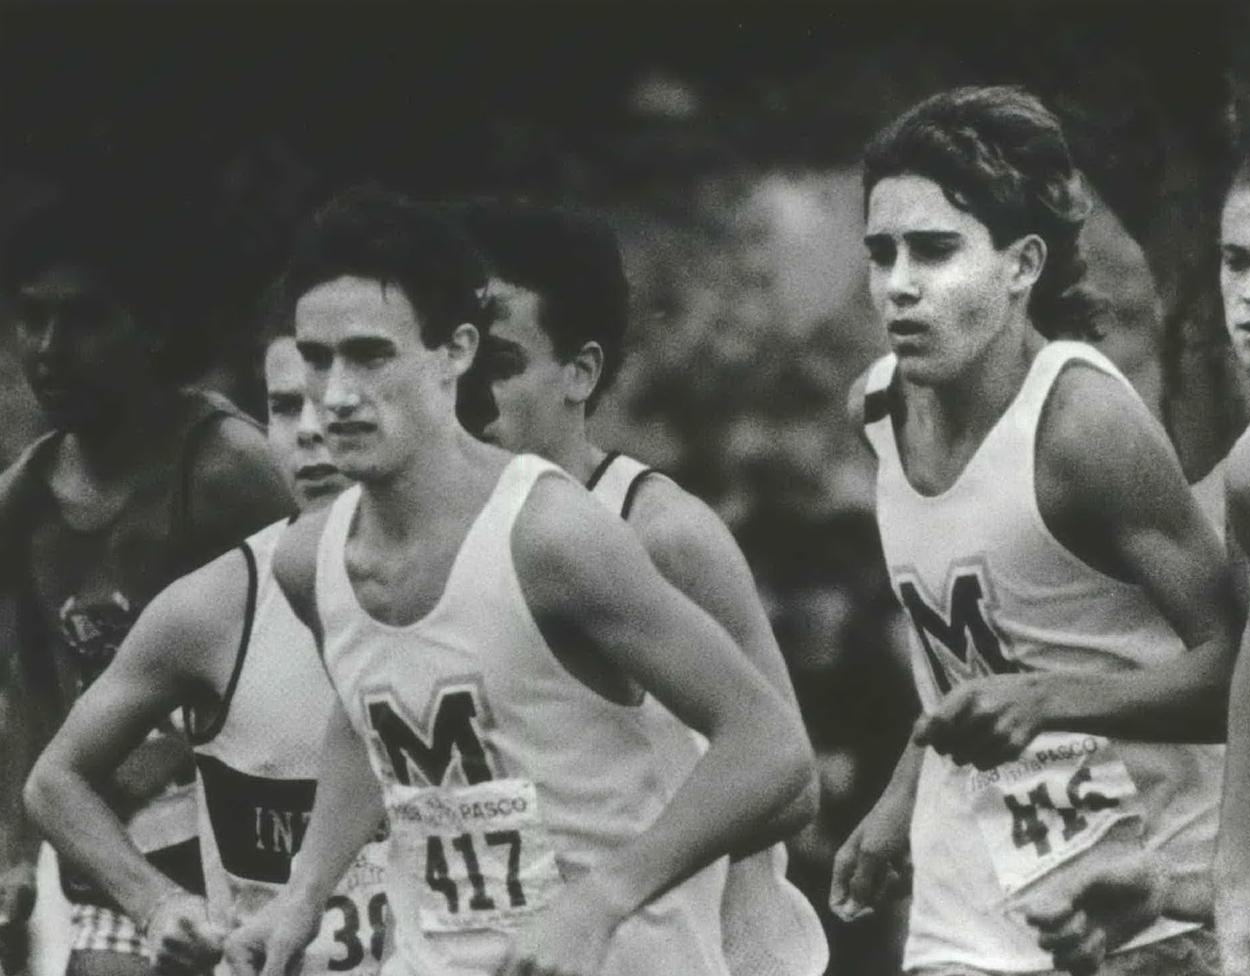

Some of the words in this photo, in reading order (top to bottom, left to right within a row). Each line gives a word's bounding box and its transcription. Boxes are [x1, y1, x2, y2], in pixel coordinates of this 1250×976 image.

[896, 562, 1030, 697] M
[362, 680, 499, 786] M
[459, 796, 527, 820] PASCO
[425, 829, 527, 914] 417
